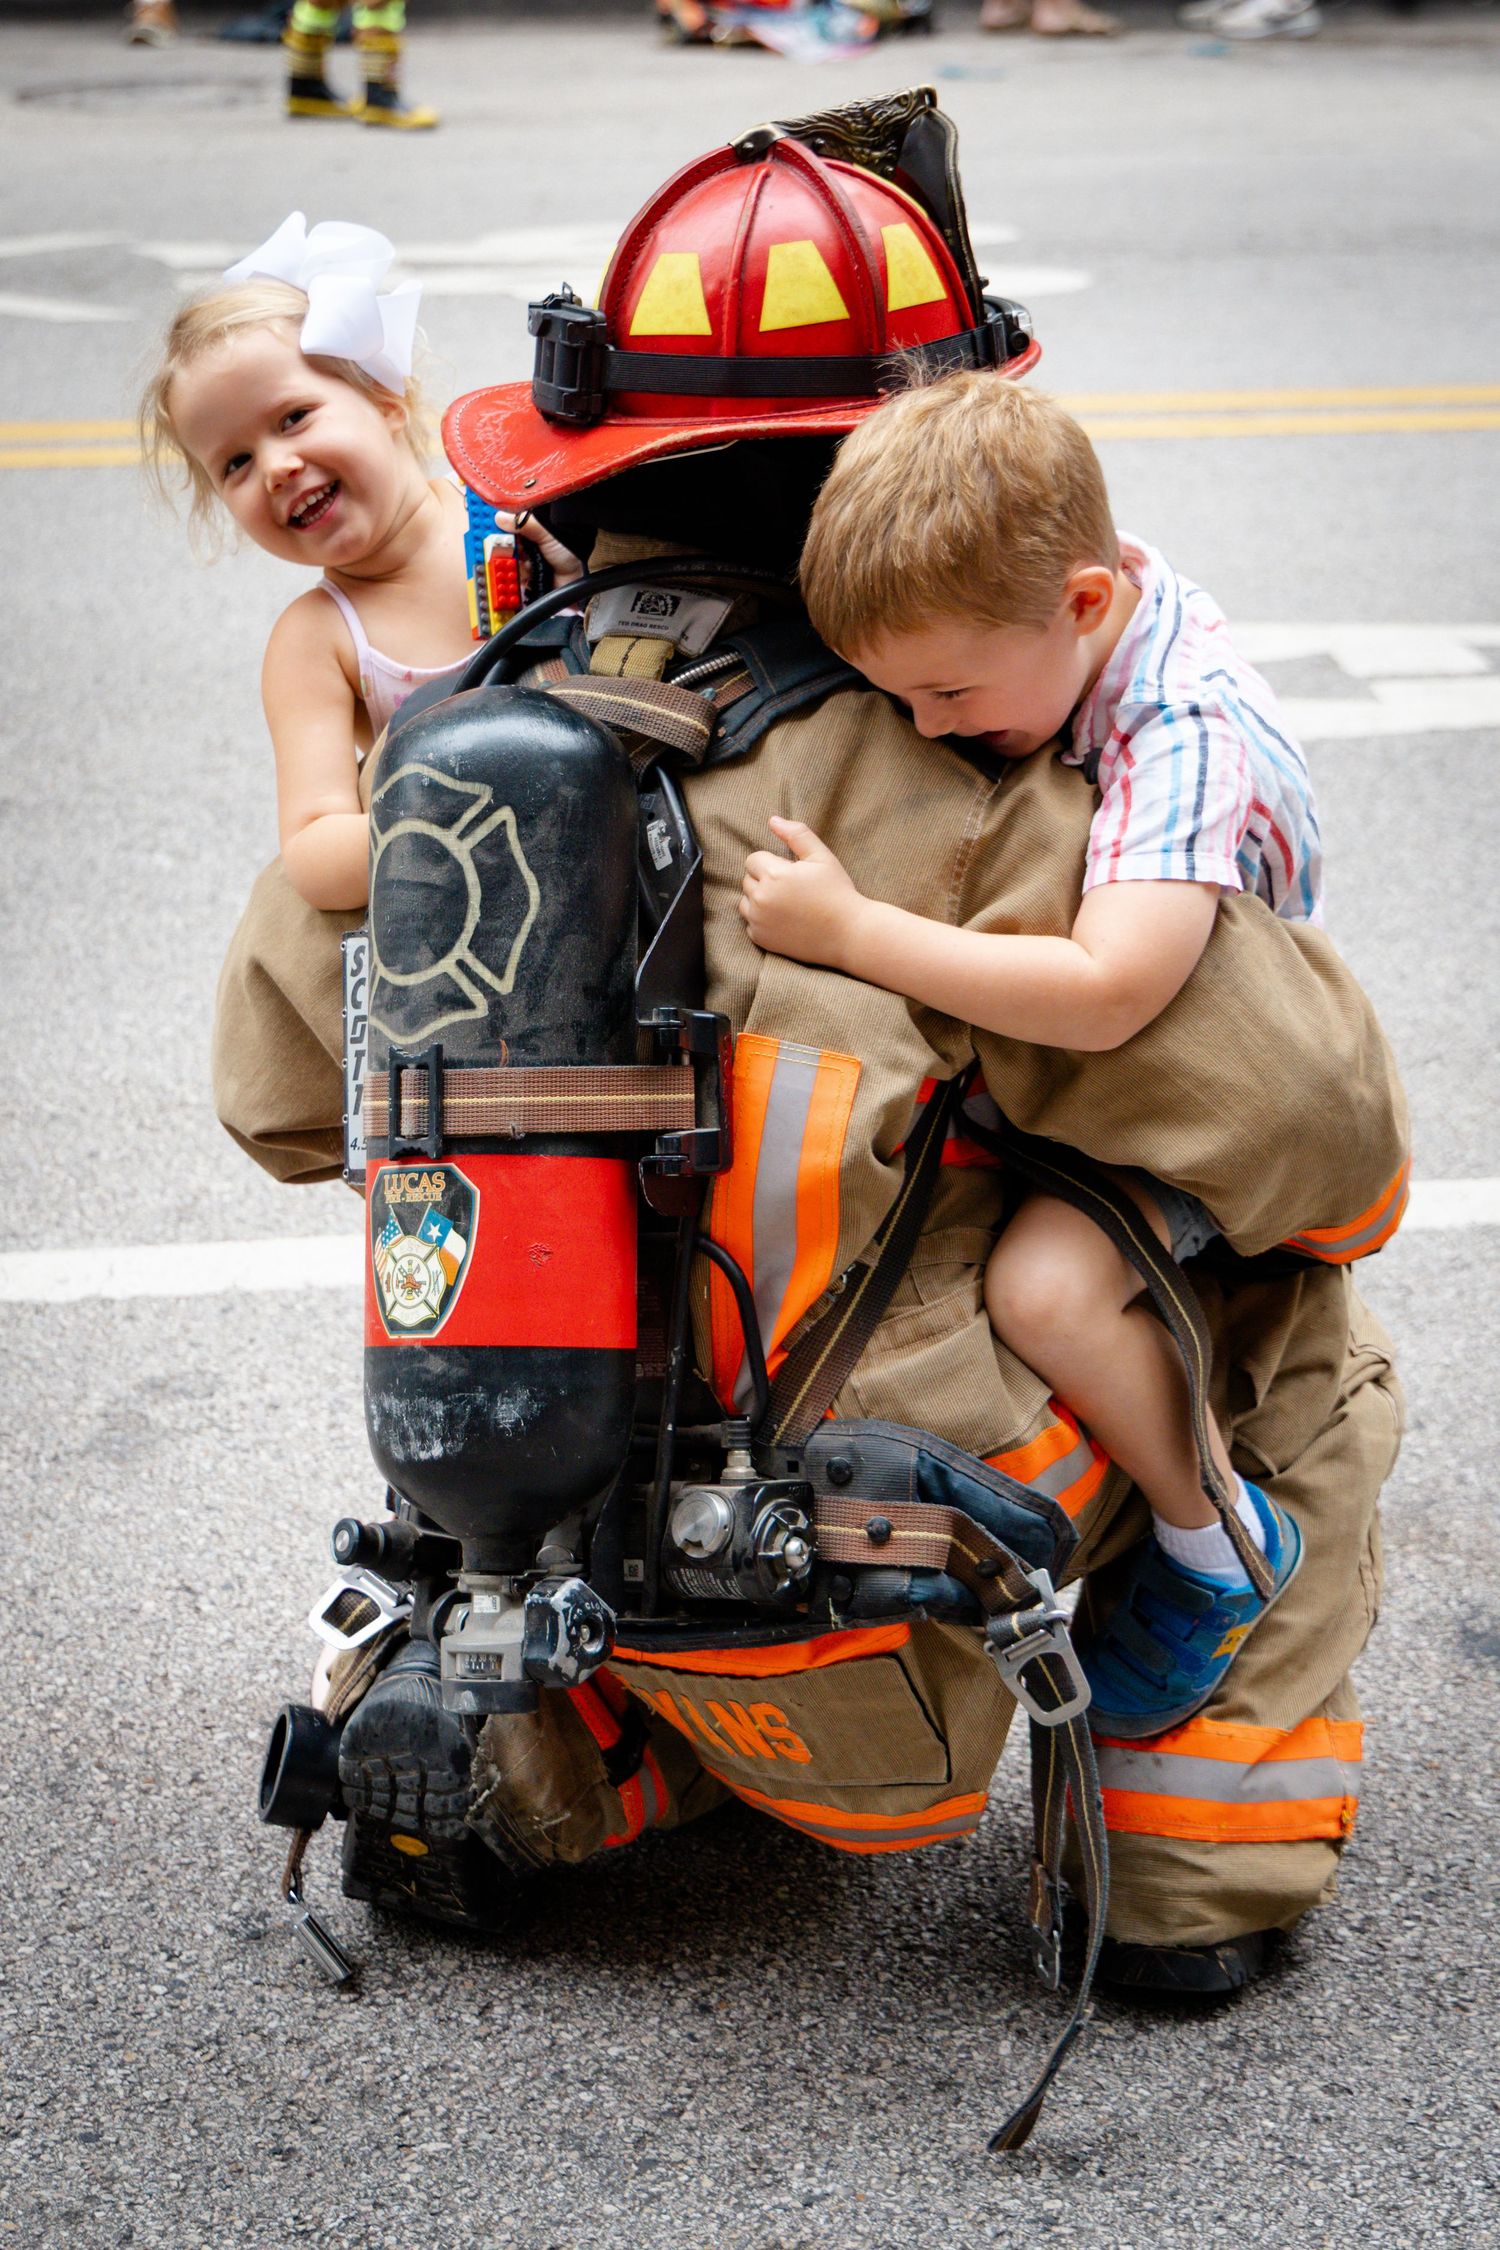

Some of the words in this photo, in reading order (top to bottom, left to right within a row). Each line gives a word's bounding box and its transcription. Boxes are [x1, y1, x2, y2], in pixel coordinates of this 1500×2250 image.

[350, 944, 368, 1116] SCOTT
[383, 1171, 446, 1194] LUCAS
[405, 1192, 443, 1203] RESCUE
